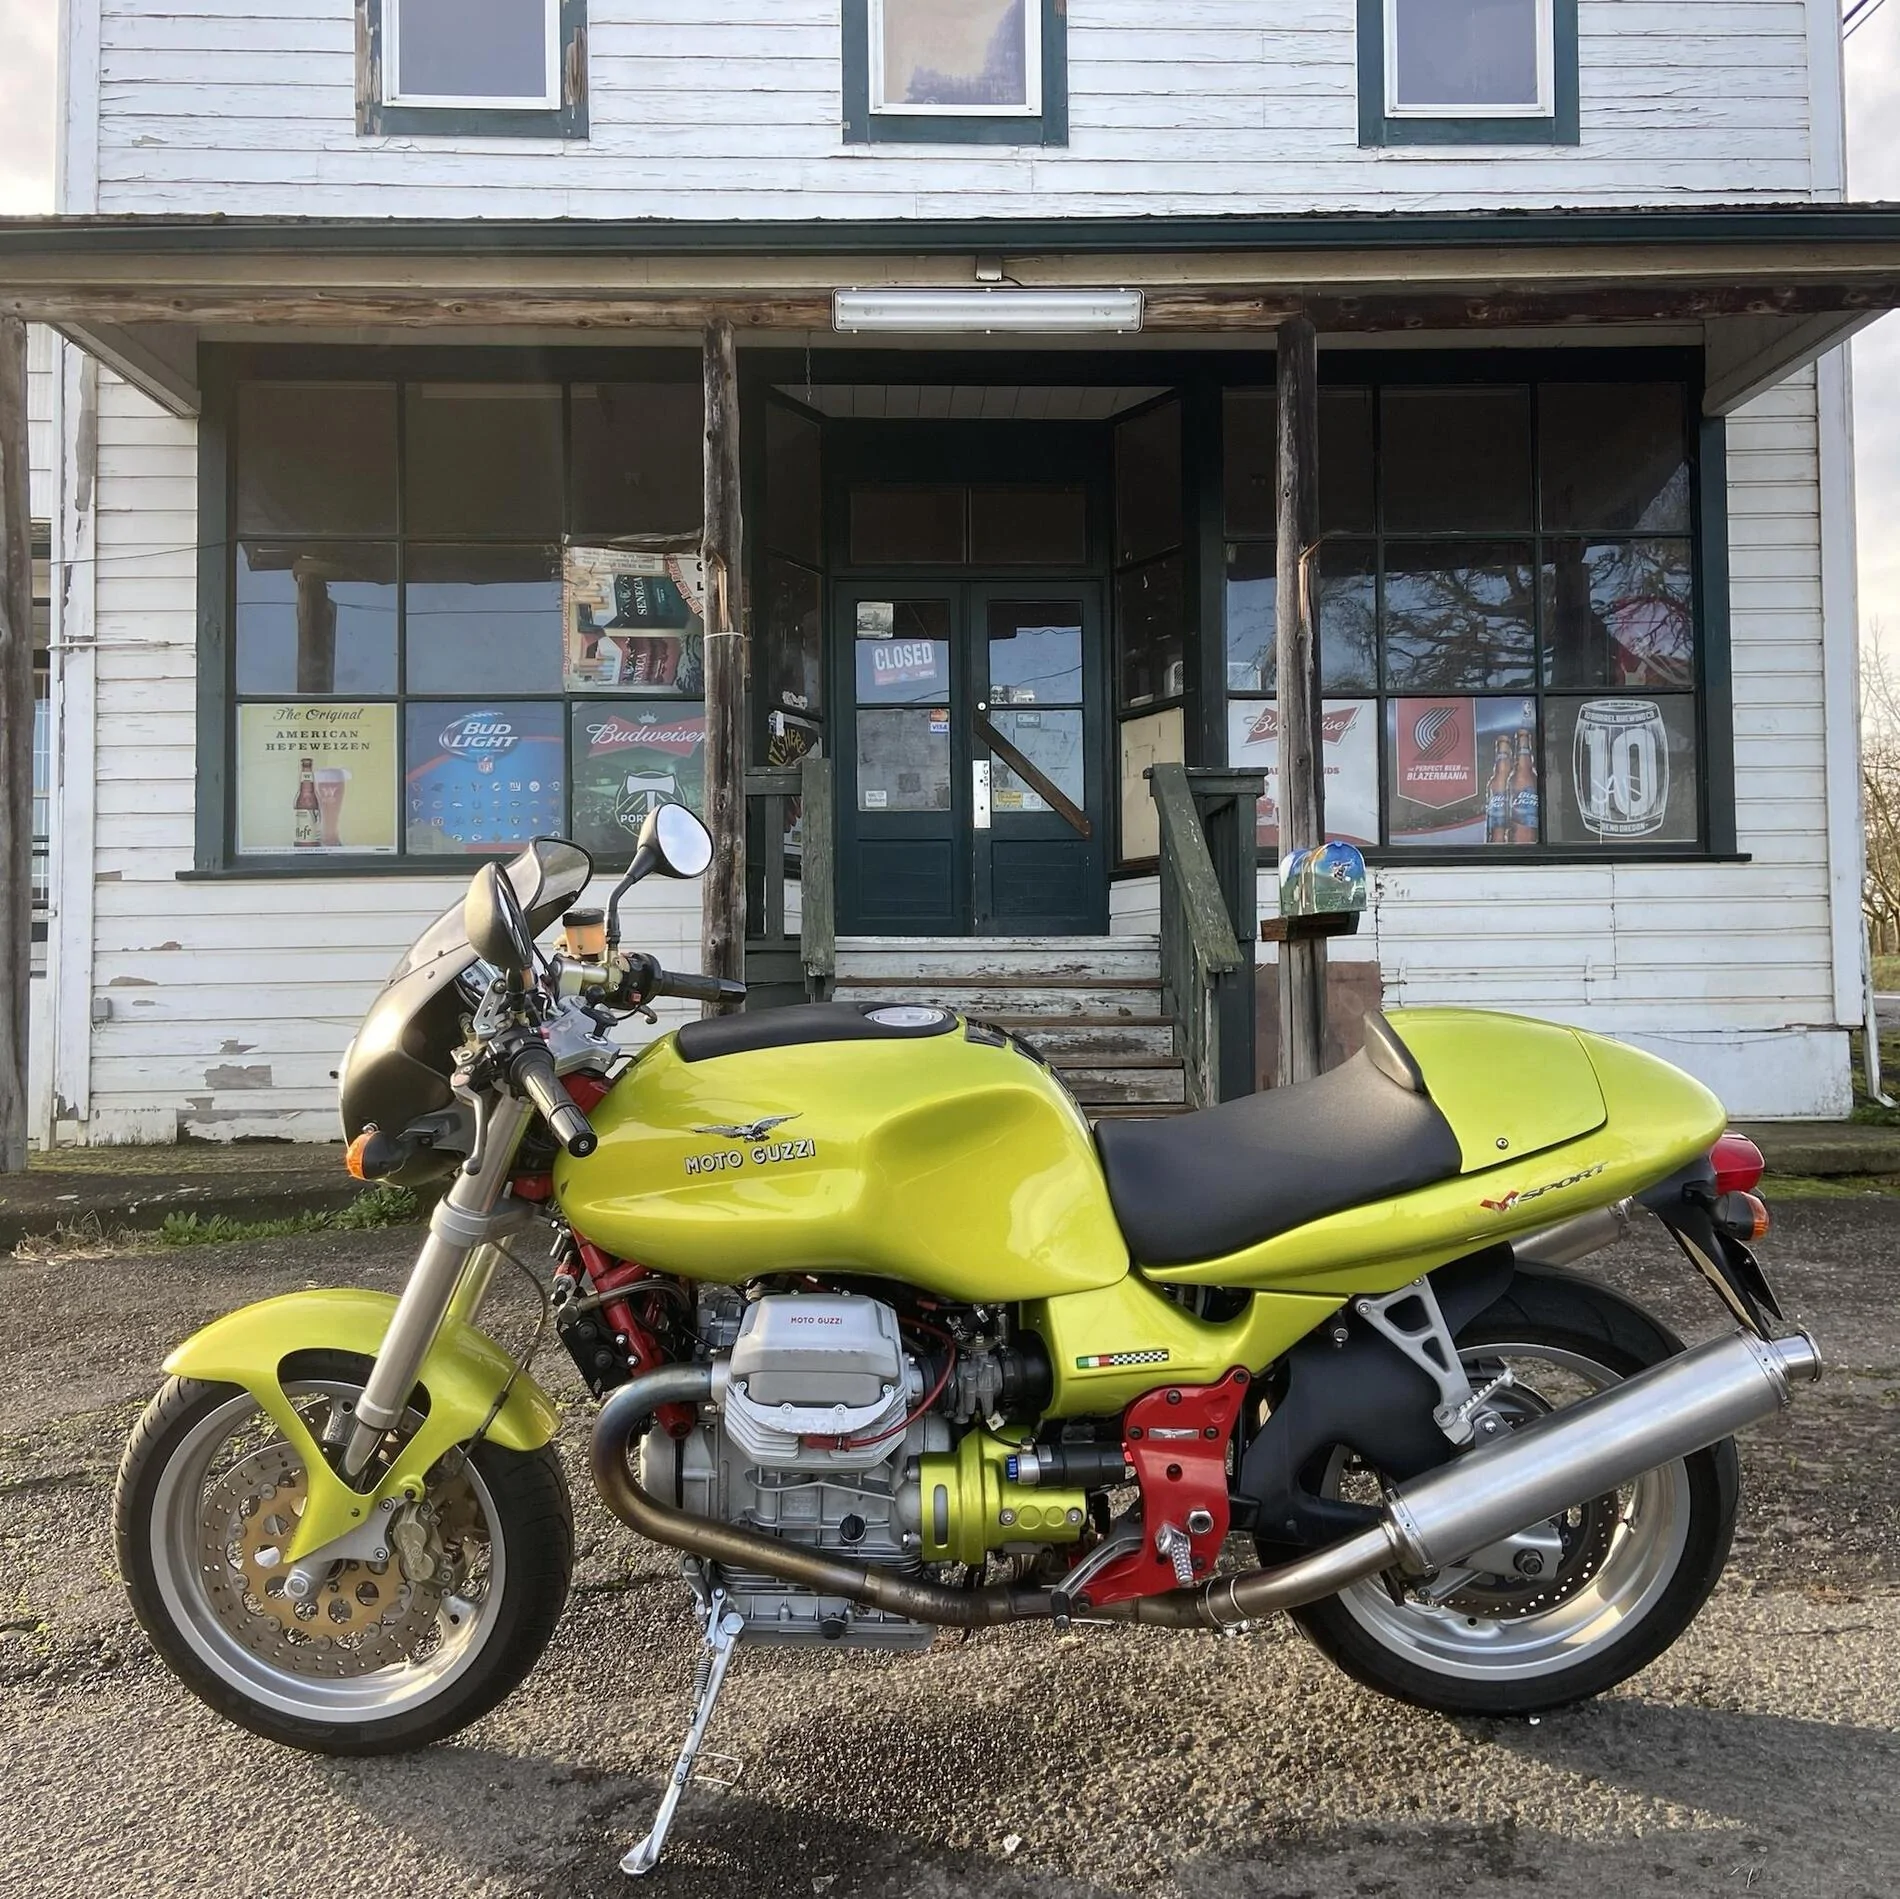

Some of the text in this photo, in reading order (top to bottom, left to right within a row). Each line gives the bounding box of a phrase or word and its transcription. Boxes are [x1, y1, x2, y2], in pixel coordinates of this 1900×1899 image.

[633, 576, 648, 616] SENECA
[874, 642, 933, 671] CLOSED
[273, 707, 364, 723] The Original
[276, 730, 359, 739] AMERICAN
[461, 722, 512, 735] BUD
[265, 742, 371, 751] HEFEWEIZEN
[450, 736, 519, 748] LIGHT
[1407, 772, 1468, 781] BLAZERMANIA
[1584, 728, 1658, 817] 10
[684, 1138, 816, 1175] MOTO GUZZI
[1518, 1162, 1609, 1202] SPORT
